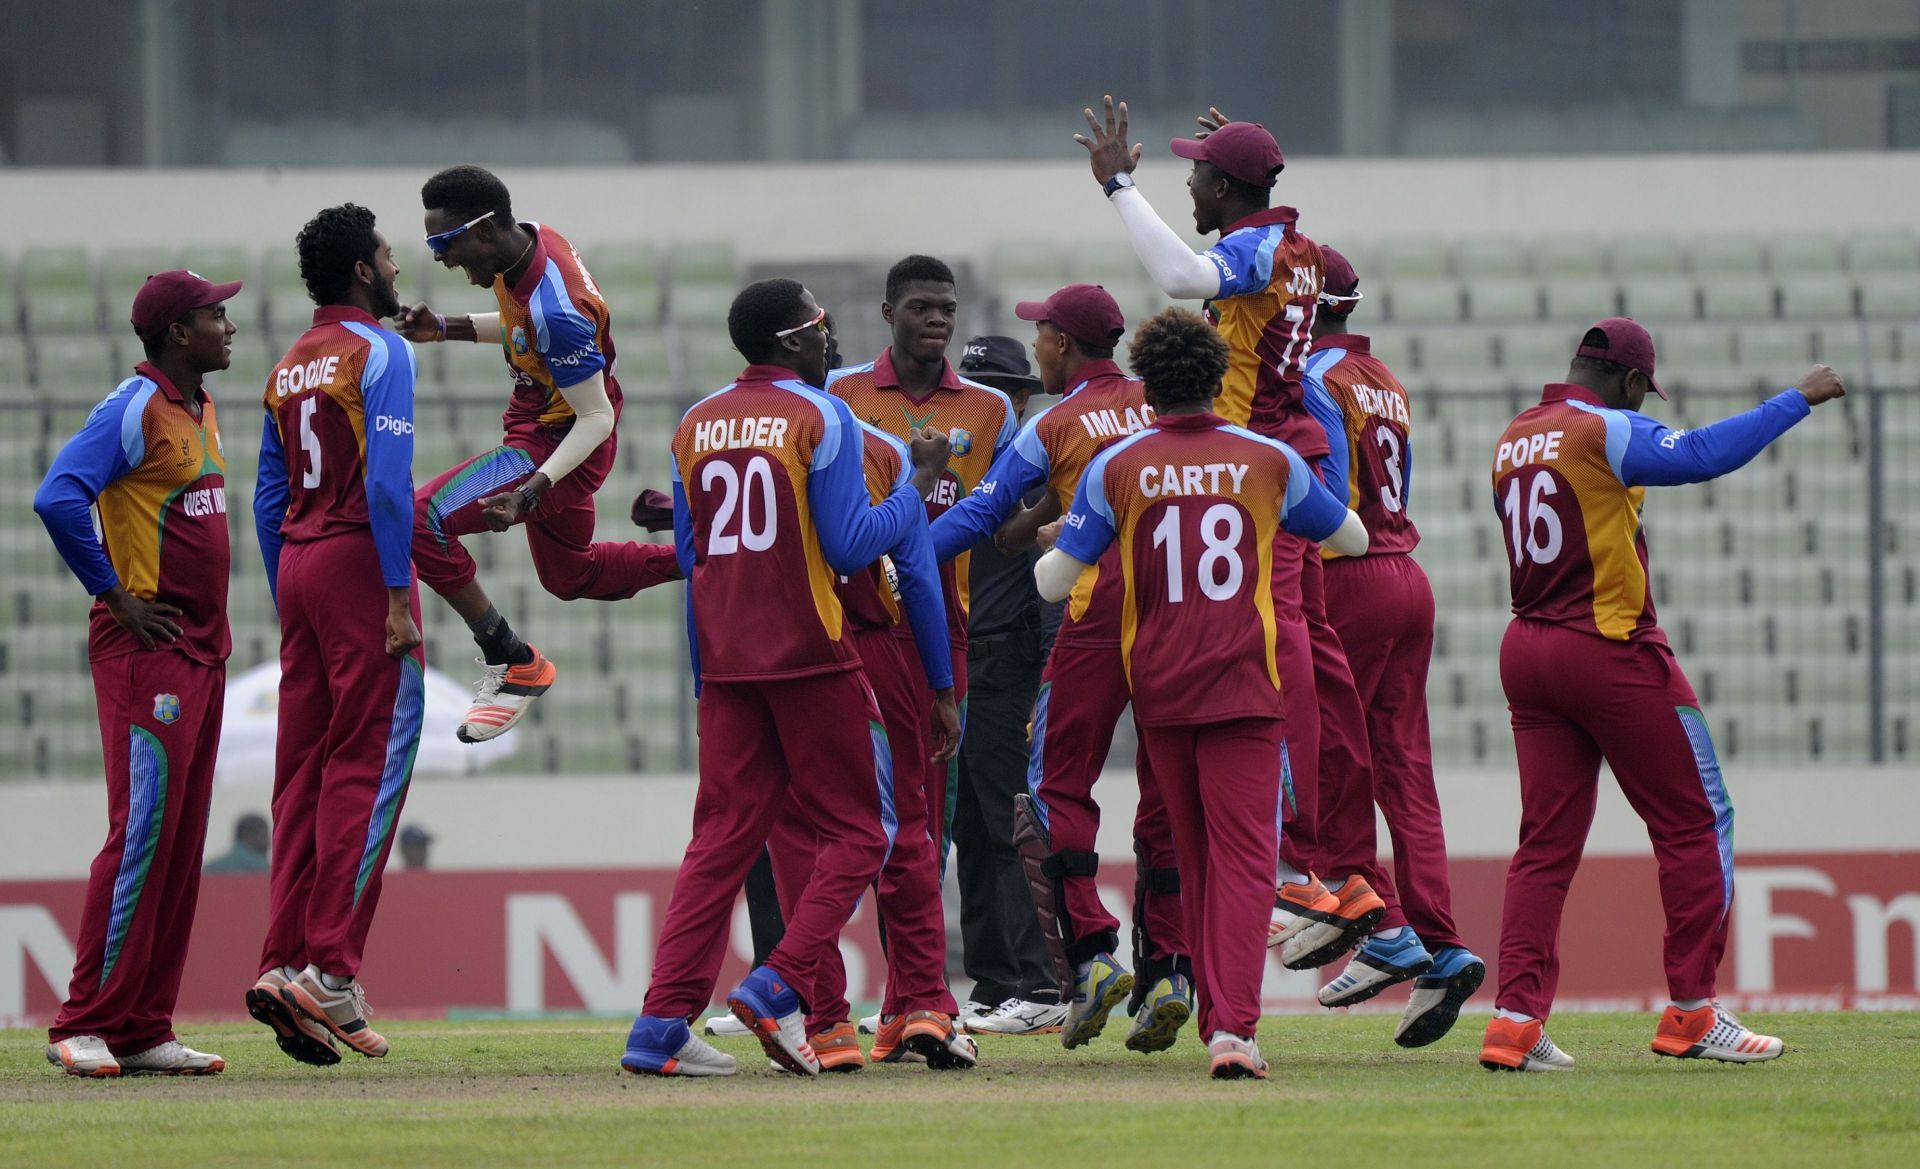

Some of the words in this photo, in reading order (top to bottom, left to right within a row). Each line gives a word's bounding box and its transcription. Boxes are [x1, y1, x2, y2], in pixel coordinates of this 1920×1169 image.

[300, 395, 322, 489] 5
[694, 416, 788, 453] HOLDER
[1376, 425, 1403, 513] 3
[1495, 430, 1564, 473] POPE
[183, 488, 214, 517] WEST
[701, 455, 777, 556] 20
[1138, 463, 1250, 498] CARTY
[1504, 470, 1563, 569] 16
[1152, 502, 1244, 604] 18
